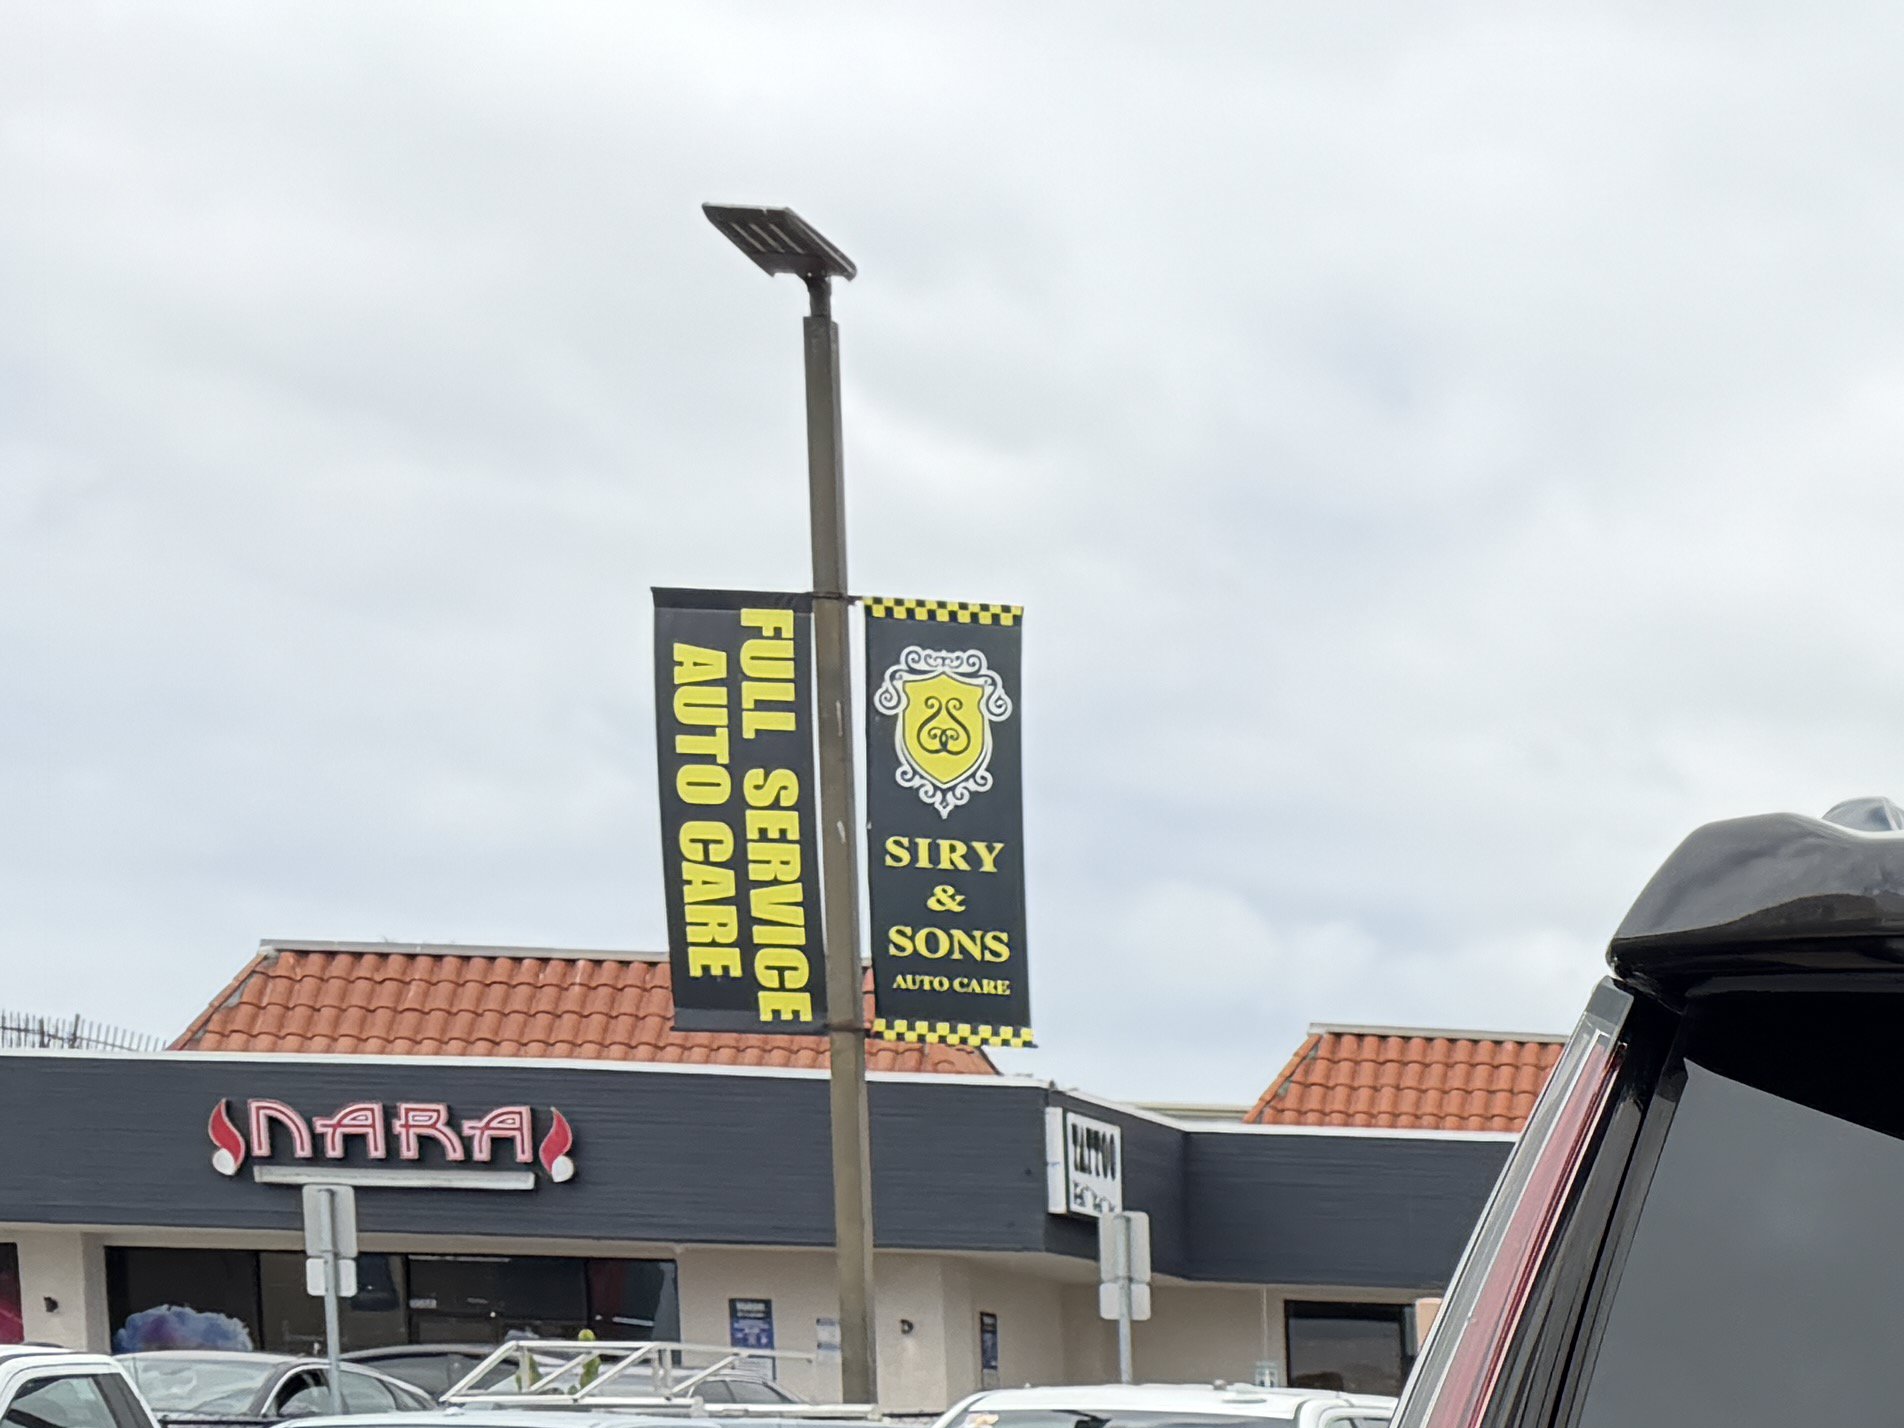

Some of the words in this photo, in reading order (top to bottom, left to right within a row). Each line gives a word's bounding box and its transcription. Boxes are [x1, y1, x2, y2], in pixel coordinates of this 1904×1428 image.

[740, 608, 796, 740] FULL
[673, 643, 732, 806] AUTO
[885, 836, 1004, 873] SIRY
[679, 820, 742, 979] CARE
[742, 767, 813, 1023] SERVICE
[927, 885, 966, 913] &
[888, 926, 1011, 963] SONS
[892, 974, 950, 992] AUTO
[952, 977, 1011, 996] CARE
[248, 1098, 534, 1163] NARA
